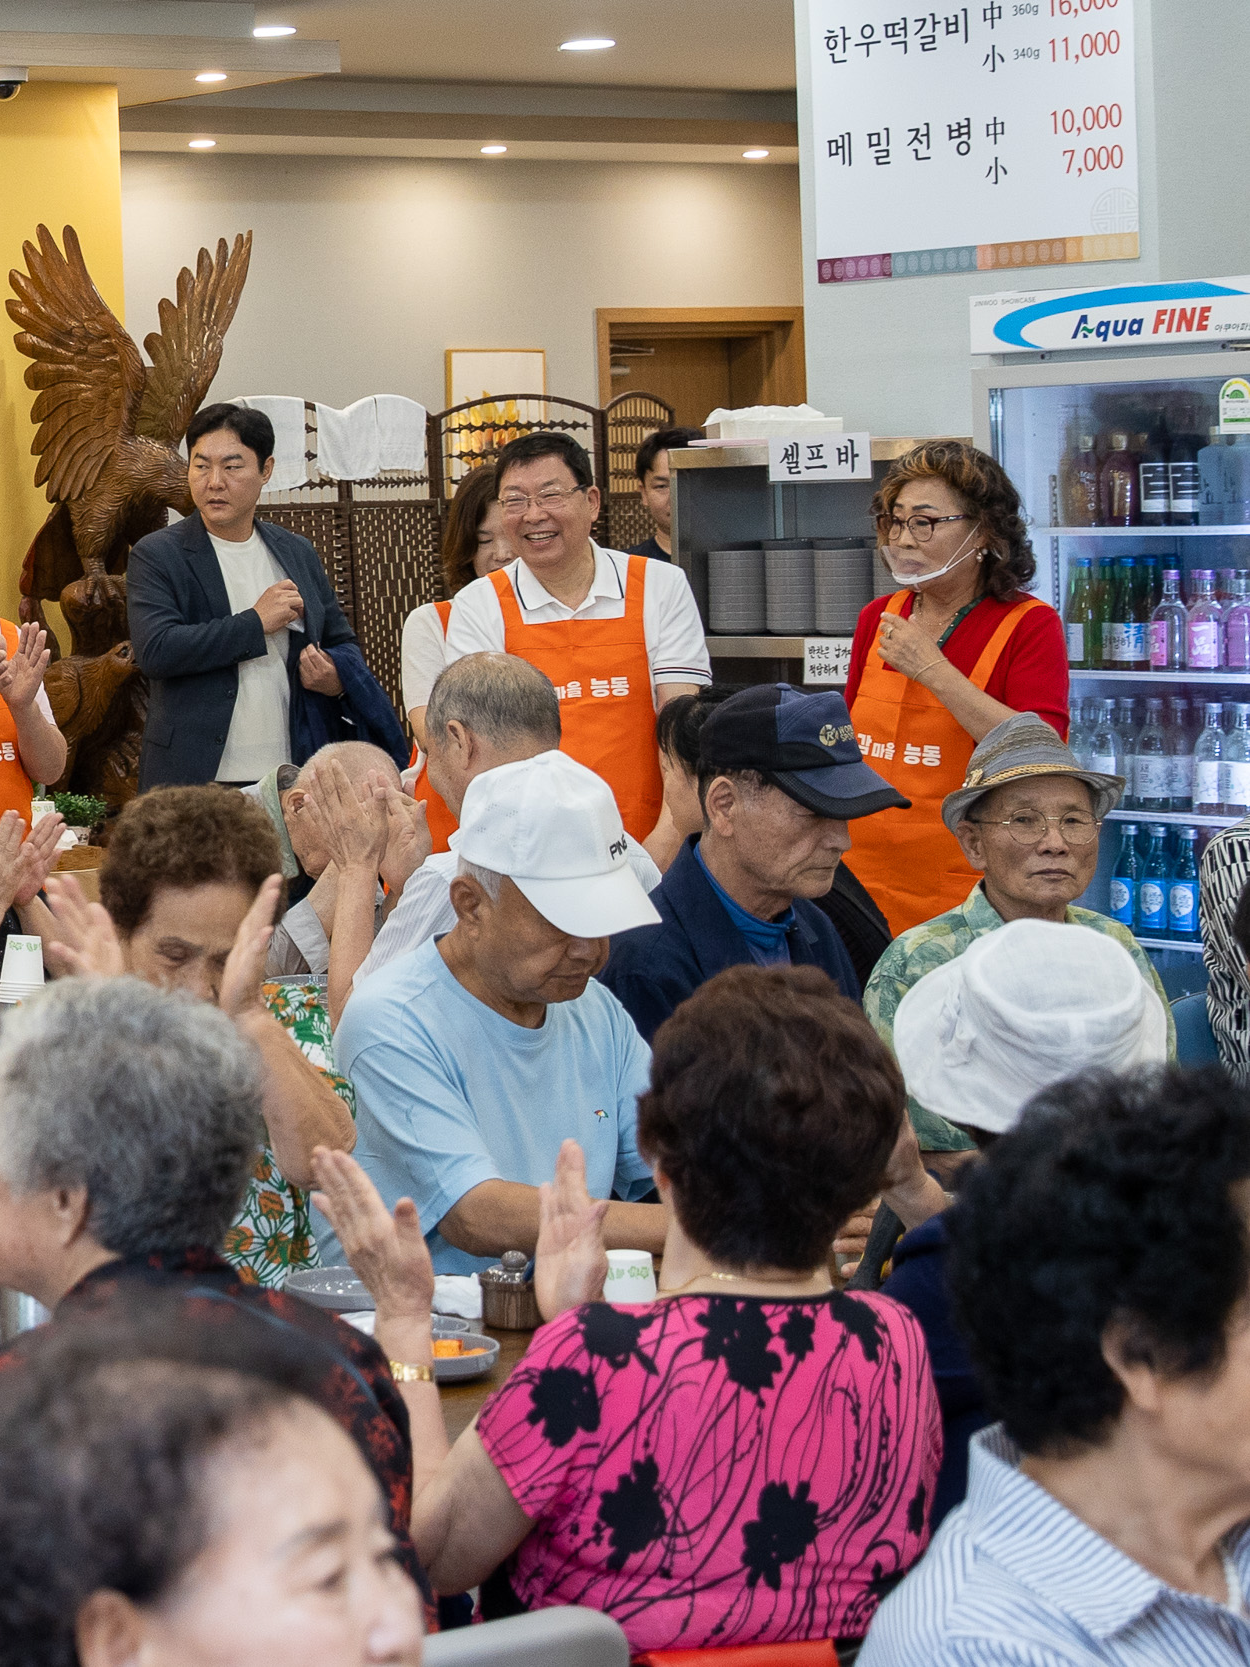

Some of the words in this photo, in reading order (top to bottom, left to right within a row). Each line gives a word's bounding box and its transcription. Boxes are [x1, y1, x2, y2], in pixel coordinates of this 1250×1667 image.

[824, 8, 970, 64] 한우떡갈비
[982, 1, 1003, 30] 中
[1012, 3, 1039, 16] 360g
[1050, 0, 1119, 18] 16,
[982, 44, 1005, 73] 小
[1013, 47, 1040, 60] 340g
[1049, 29, 1120, 64] 11,000
[827, 118, 973, 167] 메밀전병
[985, 117, 1005, 146] 中
[1050, 103, 1122, 137] 10,000
[985, 156, 1008, 185] 小
[1062, 144, 1124, 177] 7,000
[1071, 315, 1144, 341] Aqua
[1152, 306, 1212, 334] FINE
[1215, 323, 1250, 332] 아쿠아파
[780, 441, 828, 475] 셀프
[836, 438, 860, 473] 바
[590, 676, 630, 697] 능동
[903, 743, 941, 767] 능동
